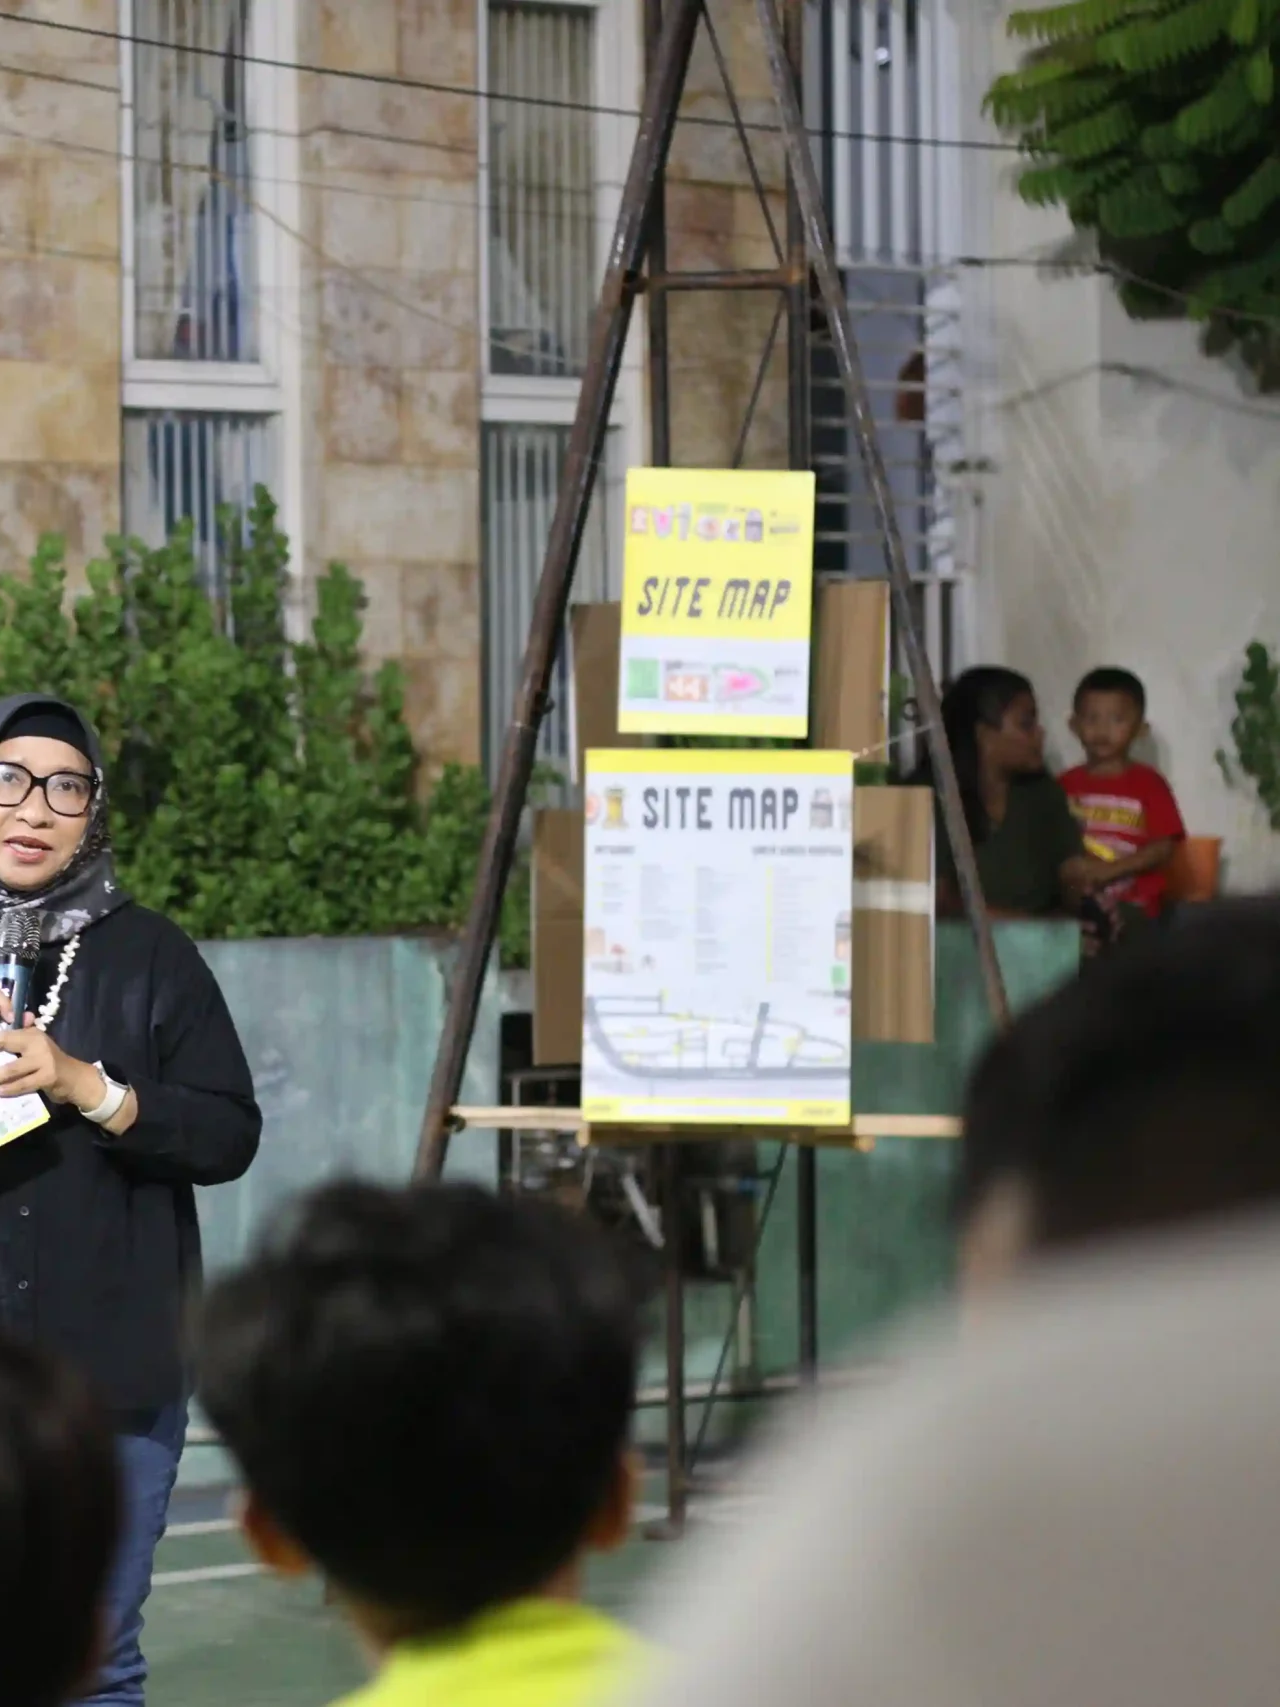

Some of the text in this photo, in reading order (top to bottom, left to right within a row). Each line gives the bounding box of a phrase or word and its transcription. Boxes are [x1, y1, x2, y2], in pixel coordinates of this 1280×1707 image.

[637, 577, 791, 620] SITE MAP
[642, 787, 799, 831] SITE MAP
